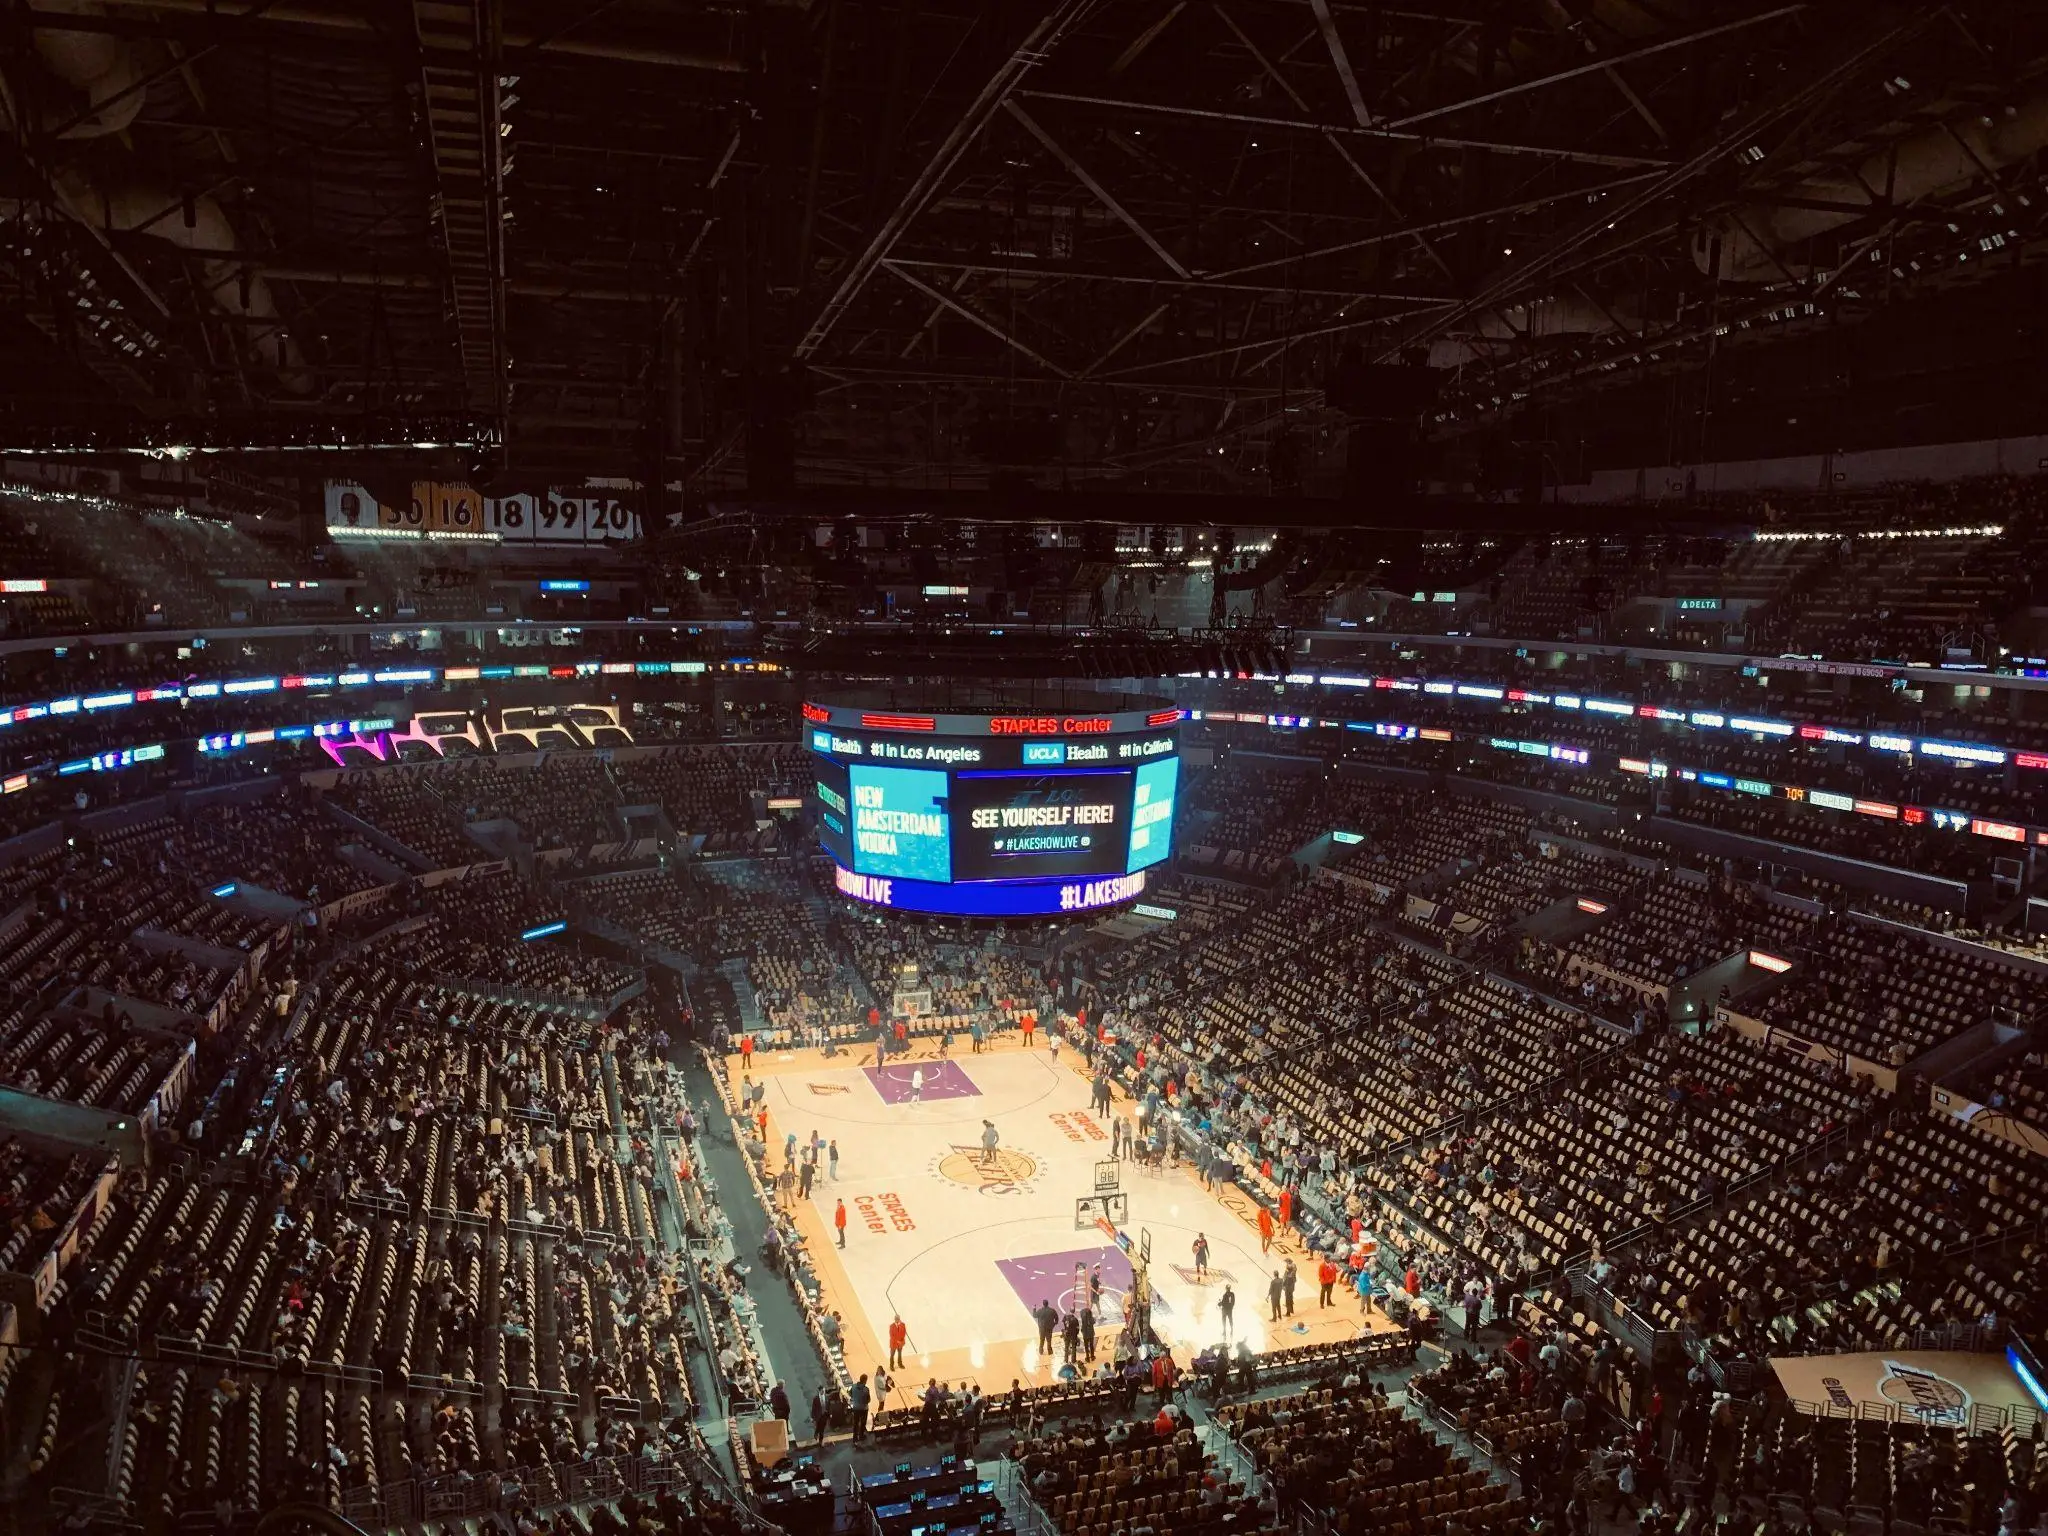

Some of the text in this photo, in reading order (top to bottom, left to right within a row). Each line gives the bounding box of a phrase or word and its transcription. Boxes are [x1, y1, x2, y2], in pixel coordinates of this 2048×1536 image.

[442, 499, 472, 526] 16
[493, 499, 524, 529] 18
[541, 499, 579, 529] 99
[591, 499, 629, 530] 20
[1689, 600, 1716, 609] DELTA
[990, 718, 1113, 734] STAPLES Center
[832, 737, 862, 755] Health
[871, 742, 885, 757] #1
[886, 743, 898, 758] in
[900, 744, 922, 760] Los
[926, 746, 981, 763] Angeles
[1029, 747, 1060, 760] UCLA
[1066, 745, 1109, 761] Health
[1119, 743, 1132, 758] #1
[1132, 743, 1143, 757] in
[855, 785, 884, 808] NEW
[1743, 782, 1771, 794] DELTA
[1811, 792, 1852, 809] STAPLES
[857, 808, 942, 837] AMSTERDAM
[971, 805, 1115, 829] SEE YOURSELF HERE!
[857, 831, 898, 856] VODKA
[1006, 835, 1079, 851] #LAKESHOWLIVE
[1048, 1113, 1086, 1142] Center
[1068, 1111, 1109, 1141] STAPLES
[854, 1196, 887, 1234] Center
[878, 1192, 916, 1231] STAPLES
